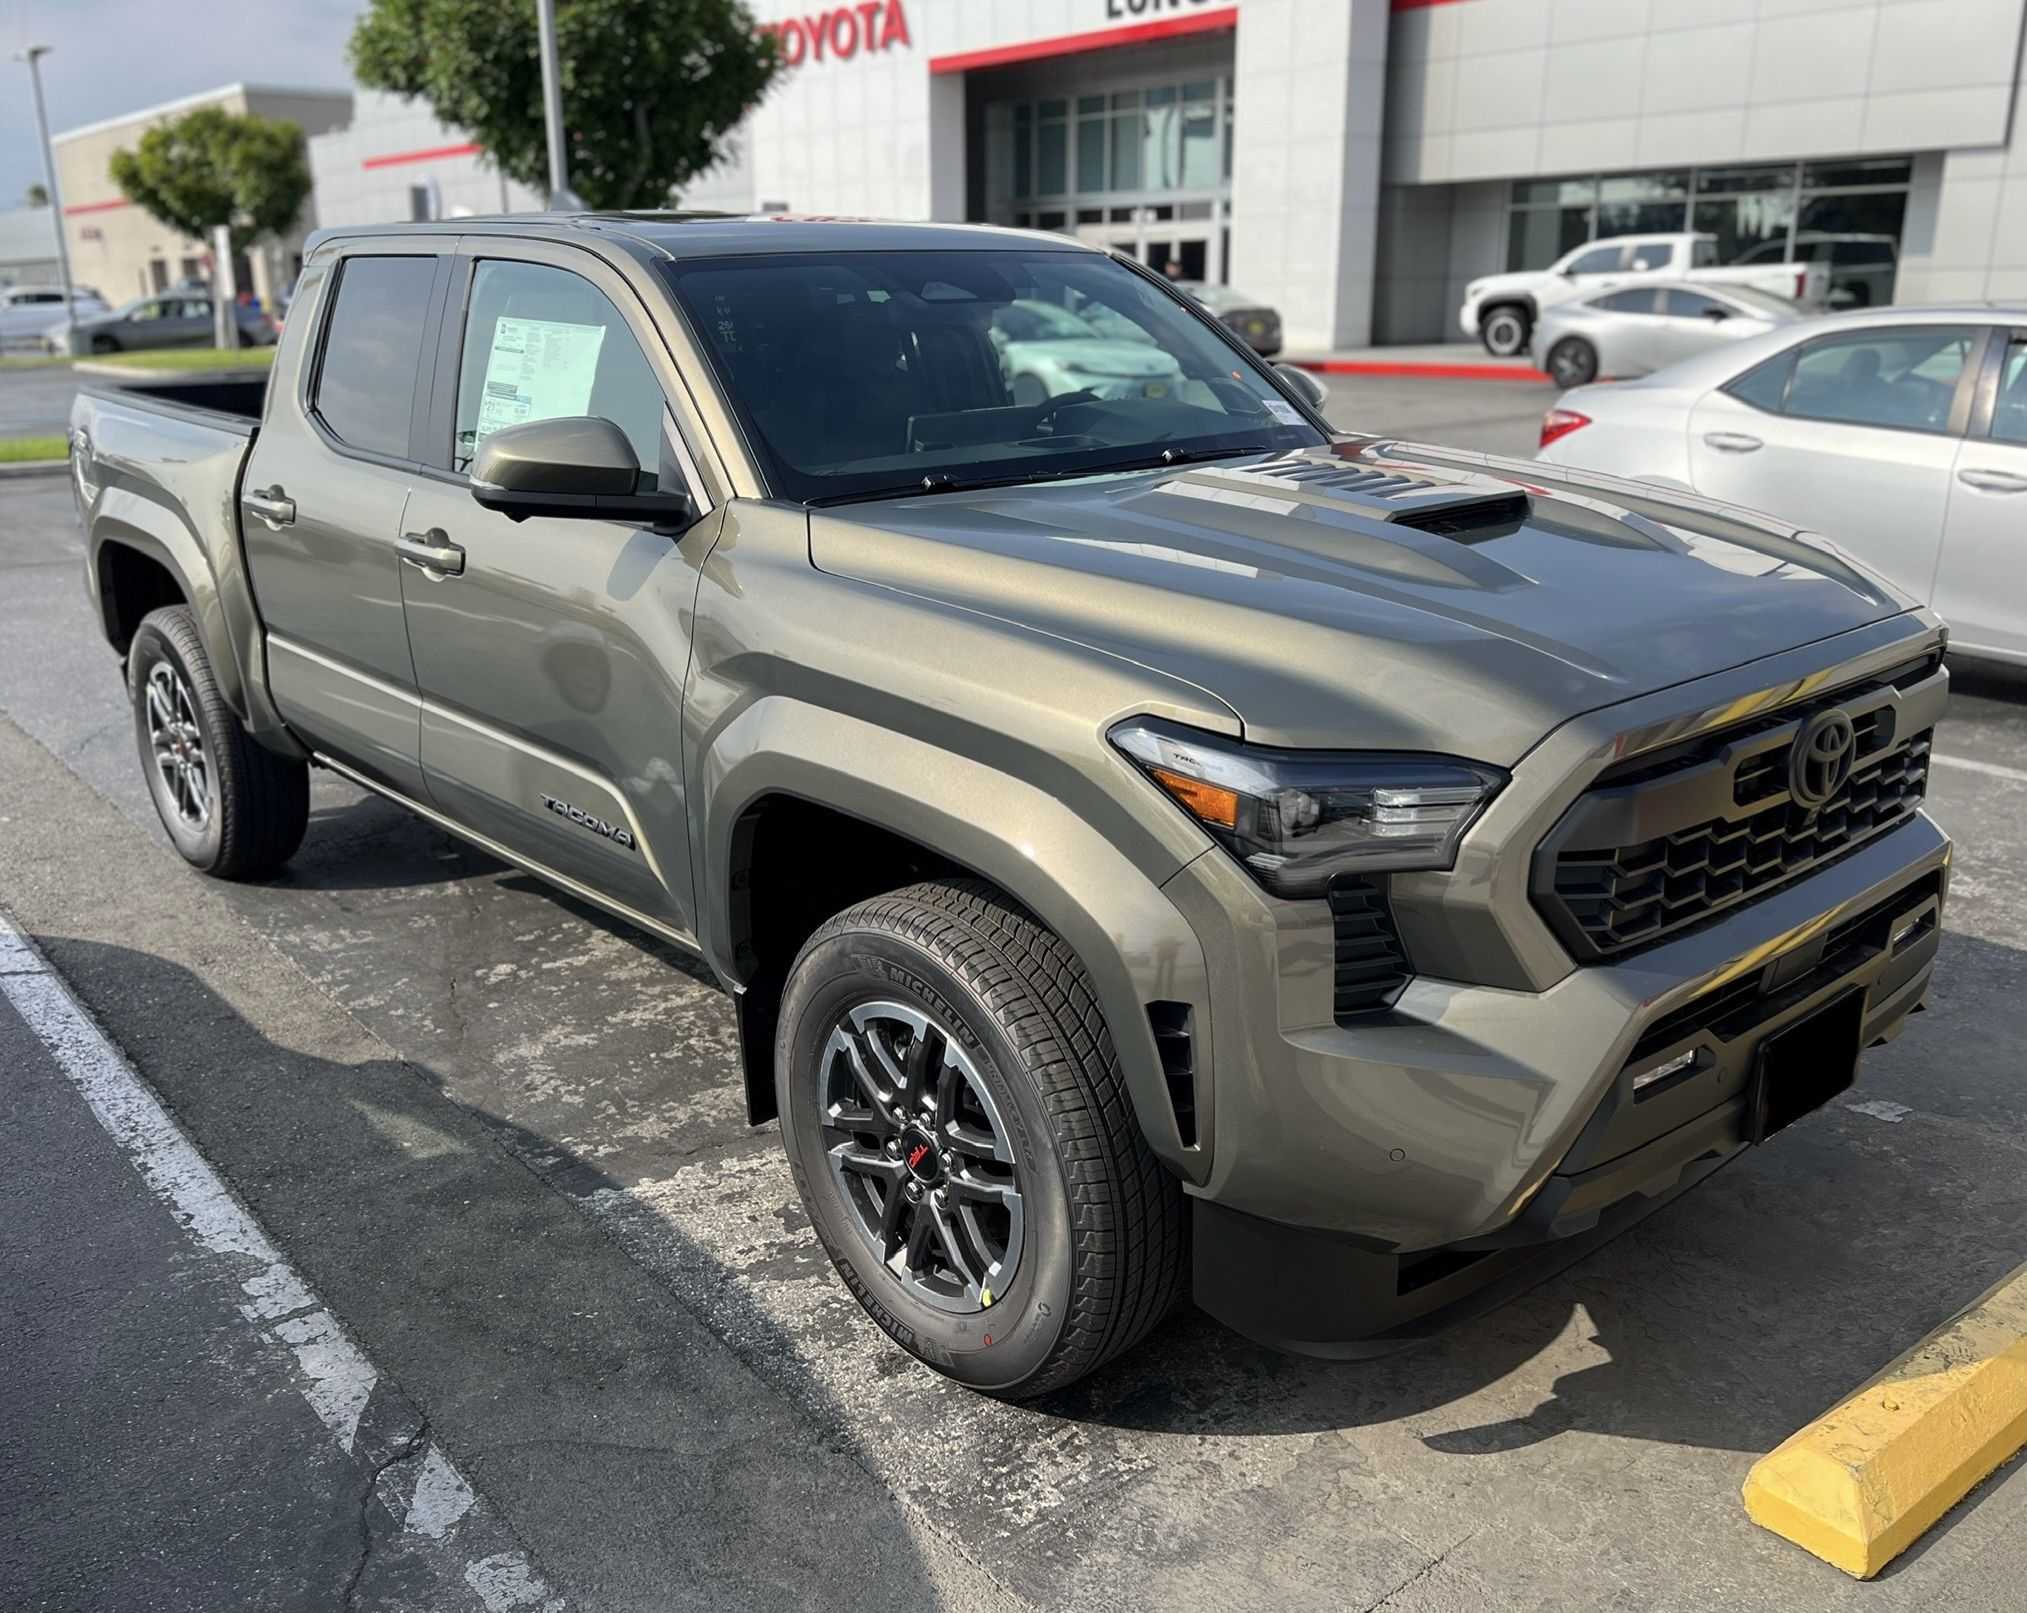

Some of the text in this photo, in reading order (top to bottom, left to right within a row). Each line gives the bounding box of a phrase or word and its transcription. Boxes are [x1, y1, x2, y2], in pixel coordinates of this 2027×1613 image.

[540, 792, 636, 851] TACOMA
[889, 966, 975, 1046] MICHELIN
[840, 1260, 915, 1347] MICHELIN
